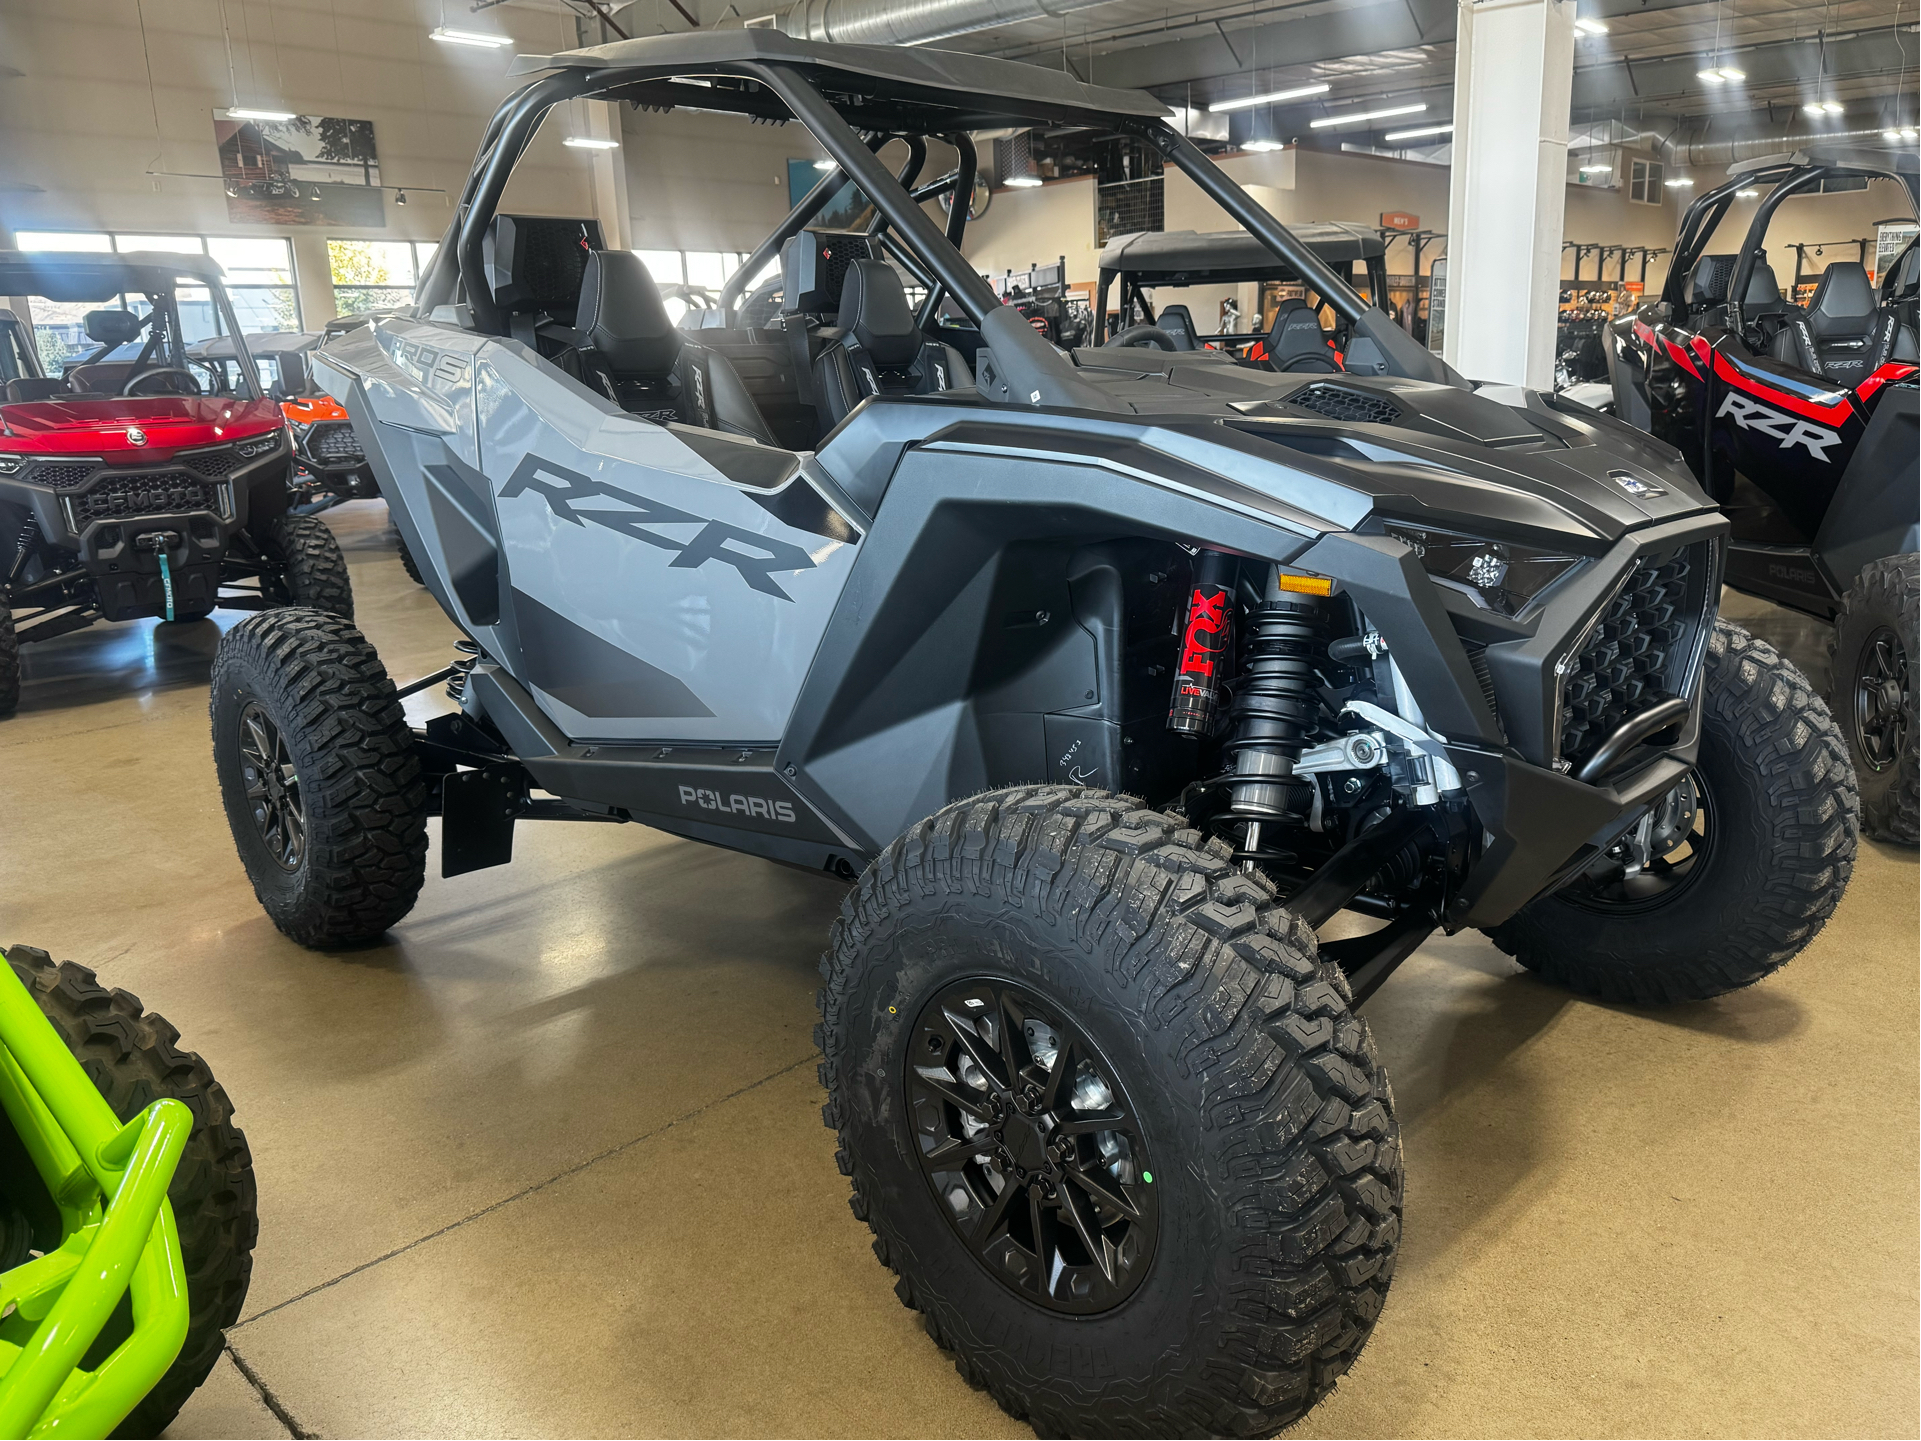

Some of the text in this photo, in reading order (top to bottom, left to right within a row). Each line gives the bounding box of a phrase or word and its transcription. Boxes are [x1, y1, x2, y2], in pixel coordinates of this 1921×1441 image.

[1878, 230, 1903, 242] EVERYTHING
[1795, 320, 1812, 346] RZR
[1883, 315, 1895, 343] RZR
[433, 354, 469, 384] S
[934, 363, 947, 391] RZ
[1824, 360, 1864, 369] RZR
[595, 369, 621, 408] RZ
[691, 364, 706, 410] RZR
[861, 366, 881, 396] RZ
[630, 409, 679, 421] ZR
[1714, 391, 1843, 464] RZR
[87, 486, 204, 510] CFMOTO
[496, 451, 818, 605] RZR
[1768, 564, 1816, 585] POLARIS
[163, 577, 174, 610] CFMOTO
[1180, 589, 1231, 678] FOX
[678, 784, 796, 823] POLARIS
